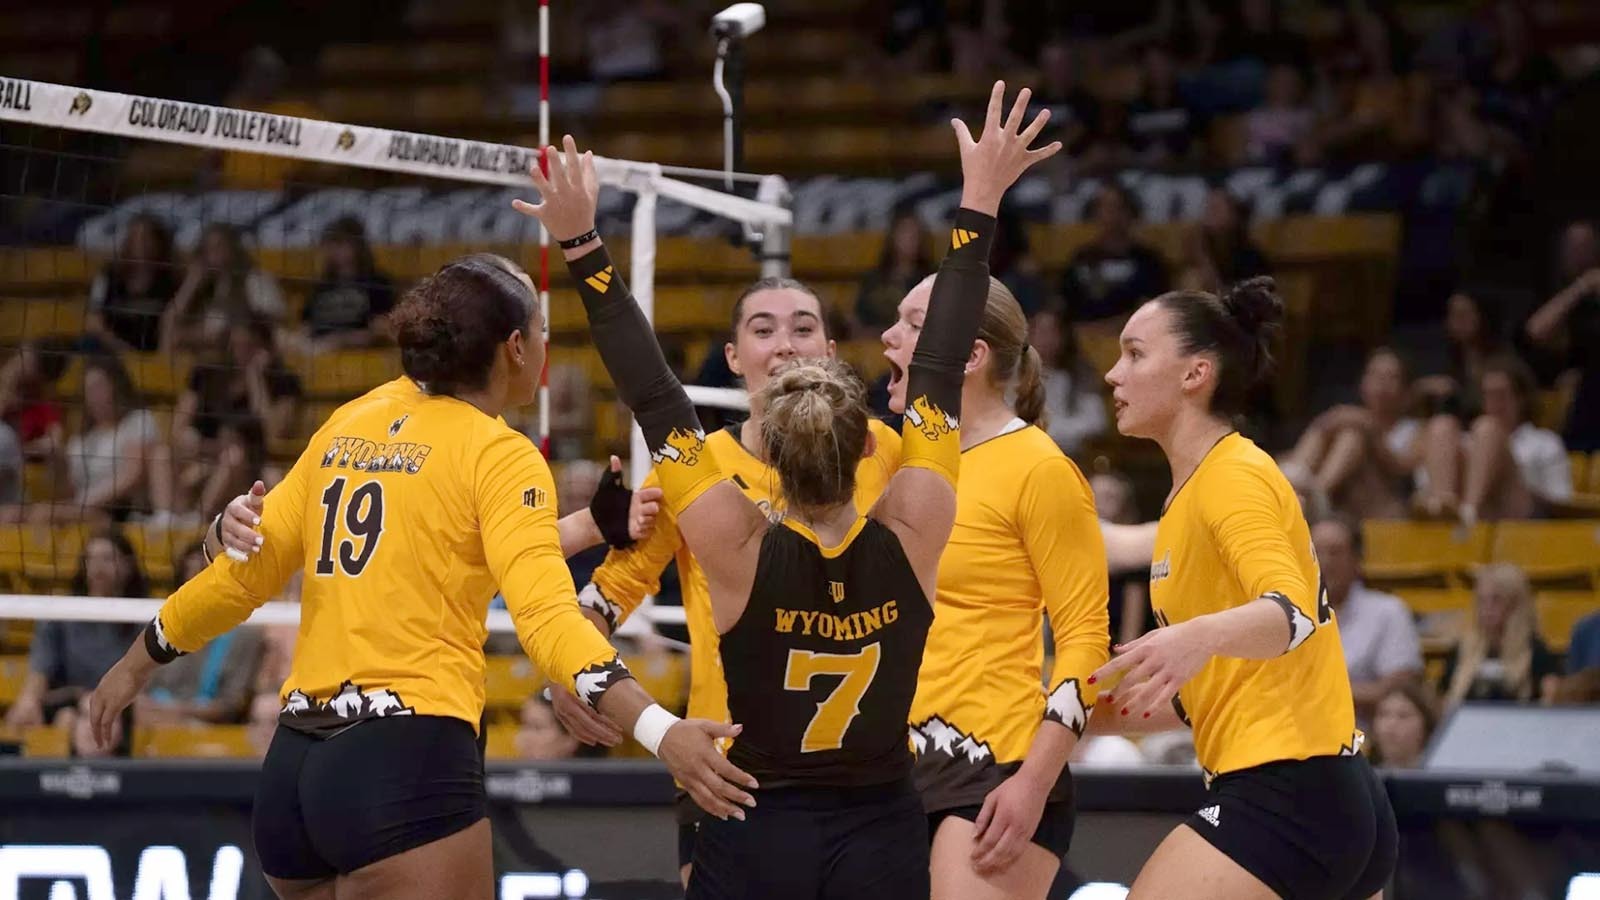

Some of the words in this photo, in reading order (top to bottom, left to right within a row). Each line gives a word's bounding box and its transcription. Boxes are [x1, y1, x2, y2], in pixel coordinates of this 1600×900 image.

[128, 98, 210, 135] COLORADO
[212, 108, 304, 147] VOLLEYBALL
[319, 436, 432, 475] WYOMING
[316, 477, 384, 577] 19
[774, 600, 899, 641] WYOMING
[783, 641, 882, 753] 7
